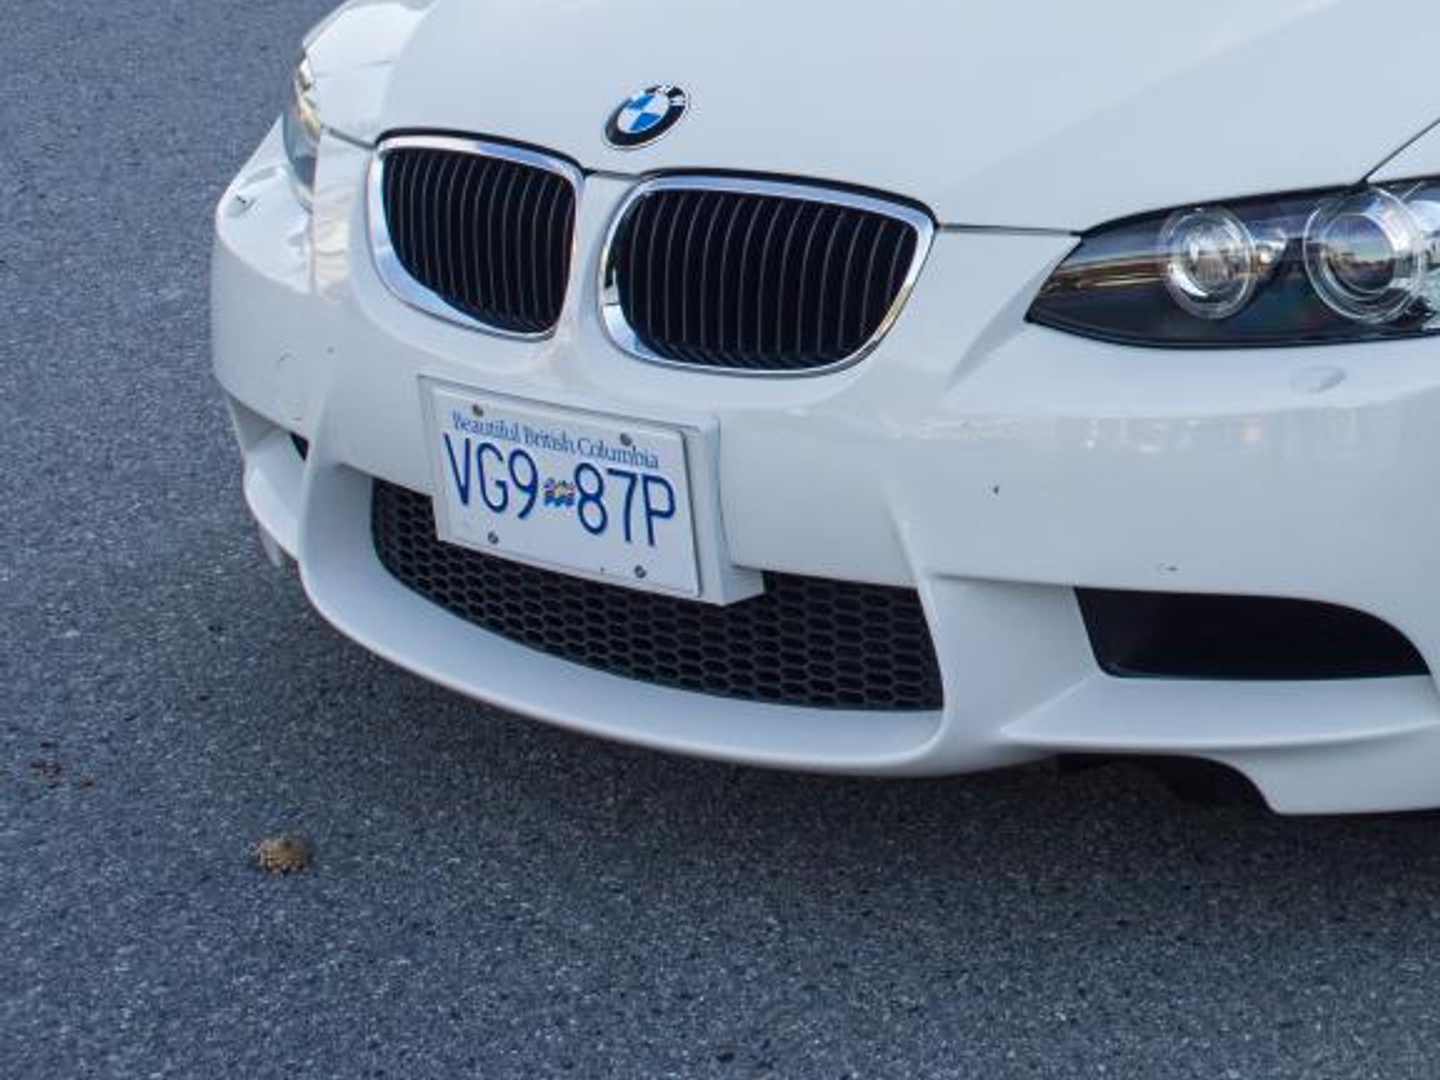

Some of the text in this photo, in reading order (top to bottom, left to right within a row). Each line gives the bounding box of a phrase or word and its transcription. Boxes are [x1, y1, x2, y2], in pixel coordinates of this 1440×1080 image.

[453, 411, 659, 468] Beautiful British Columbia
[443, 433, 676, 547] VG9 87P
